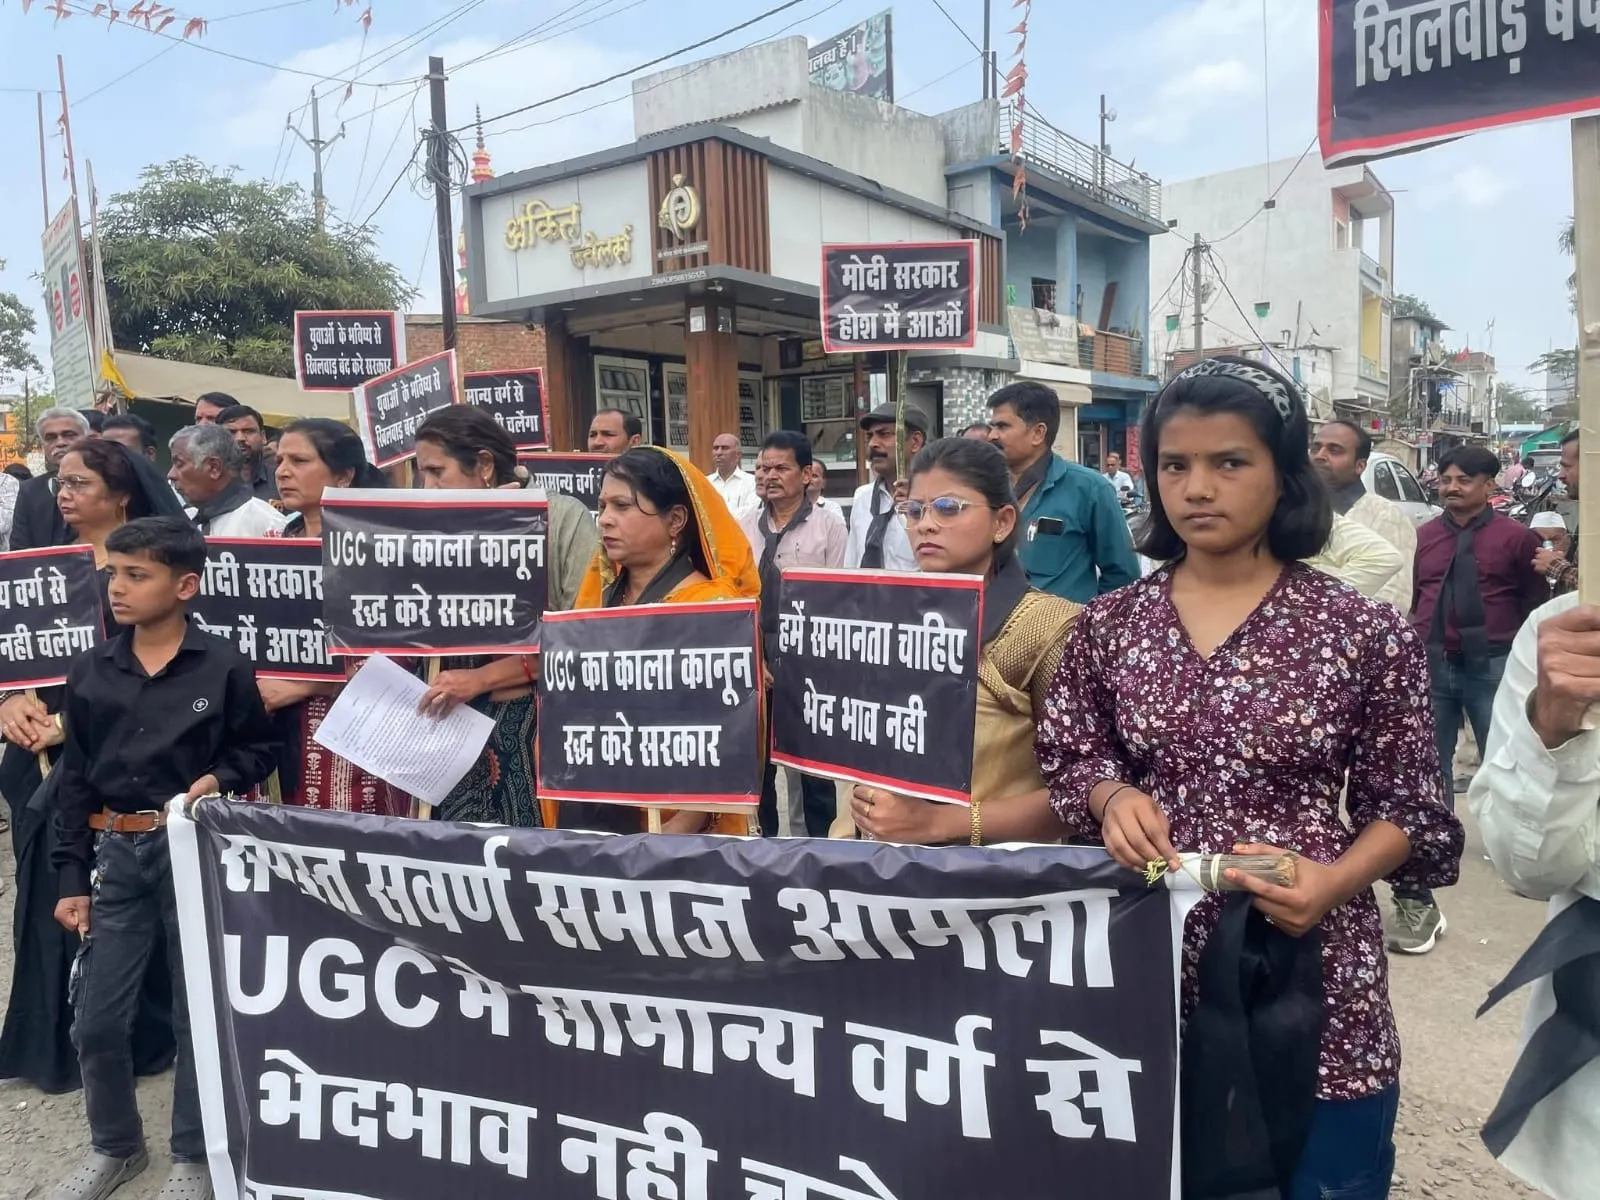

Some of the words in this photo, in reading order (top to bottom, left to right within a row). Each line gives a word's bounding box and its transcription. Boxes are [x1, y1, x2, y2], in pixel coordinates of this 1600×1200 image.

[1354, 0, 1527, 87] खिलवाड़
[841, 254, 889, 292] मोदी
[893, 260, 960, 291] सरकार
[309, 321, 335, 351] युवाओं
[337, 321, 347, 345] के
[348, 322, 373, 345] भविष्य
[374, 321, 382, 345] से
[838, 304, 879, 341] होश
[883, 302, 900, 339] में
[907, 300, 964, 339] आओं
[304, 353, 337, 380] खिलवाड़
[338, 351, 350, 375] बंद
[351, 352, 365, 375] करे
[365, 358, 392, 376] सरकार
[376, 382, 400, 421] युवाओं
[400, 379, 410, 403] के
[410, 373, 433, 400] भविष्य
[433, 366, 441, 391] से
[494, 380, 511, 404] वर्ग
[513, 379, 524, 403] से
[374, 420, 404, 449] खिलवाड़
[403, 411, 416, 437] बंद
[505, 409, 539, 434] चलेंगा
[575, 467, 595, 495] वर्ग
[329, 531, 367, 567] UGC
[373, 534, 407, 567] का
[412, 534, 475, 567] काला
[479, 534, 546, 581] कानून
[13, 566, 45, 608] वर्ग
[48, 566, 68, 605] से
[244, 563, 324, 601] सरकार
[393, 583, 433, 627] करे
[437, 593, 517, 627] सरकार
[36, 617, 95, 658] चलेंगा
[237, 614, 258, 661] में
[778, 600, 806, 656] हमें
[810, 615, 893, 666] समानता
[897, 611, 968, 675] चाहिए
[544, 649, 576, 692] UGC
[580, 651, 609, 692] का
[613, 648, 675, 691] काला
[679, 646, 753, 707] कानून
[803, 677, 837, 737] भेद
[841, 695, 881, 746] भाव
[885, 693, 928, 755] नही
[599, 711, 634, 767] करे
[637, 724, 723, 768] सरकार
[356, 835, 525, 944] सवर्ण
[524, 870, 765, 963] समाज
[777, 886, 1120, 989] आमला
[223, 933, 441, 1029] UGC
[518, 983, 824, 1099] सामान्य
[845, 1014, 997, 1139] वर्ग
[1025, 1029, 1143, 1144] से
[258, 1048, 538, 1180] भेदभाव
[556, 1110, 718, 1200] नही
